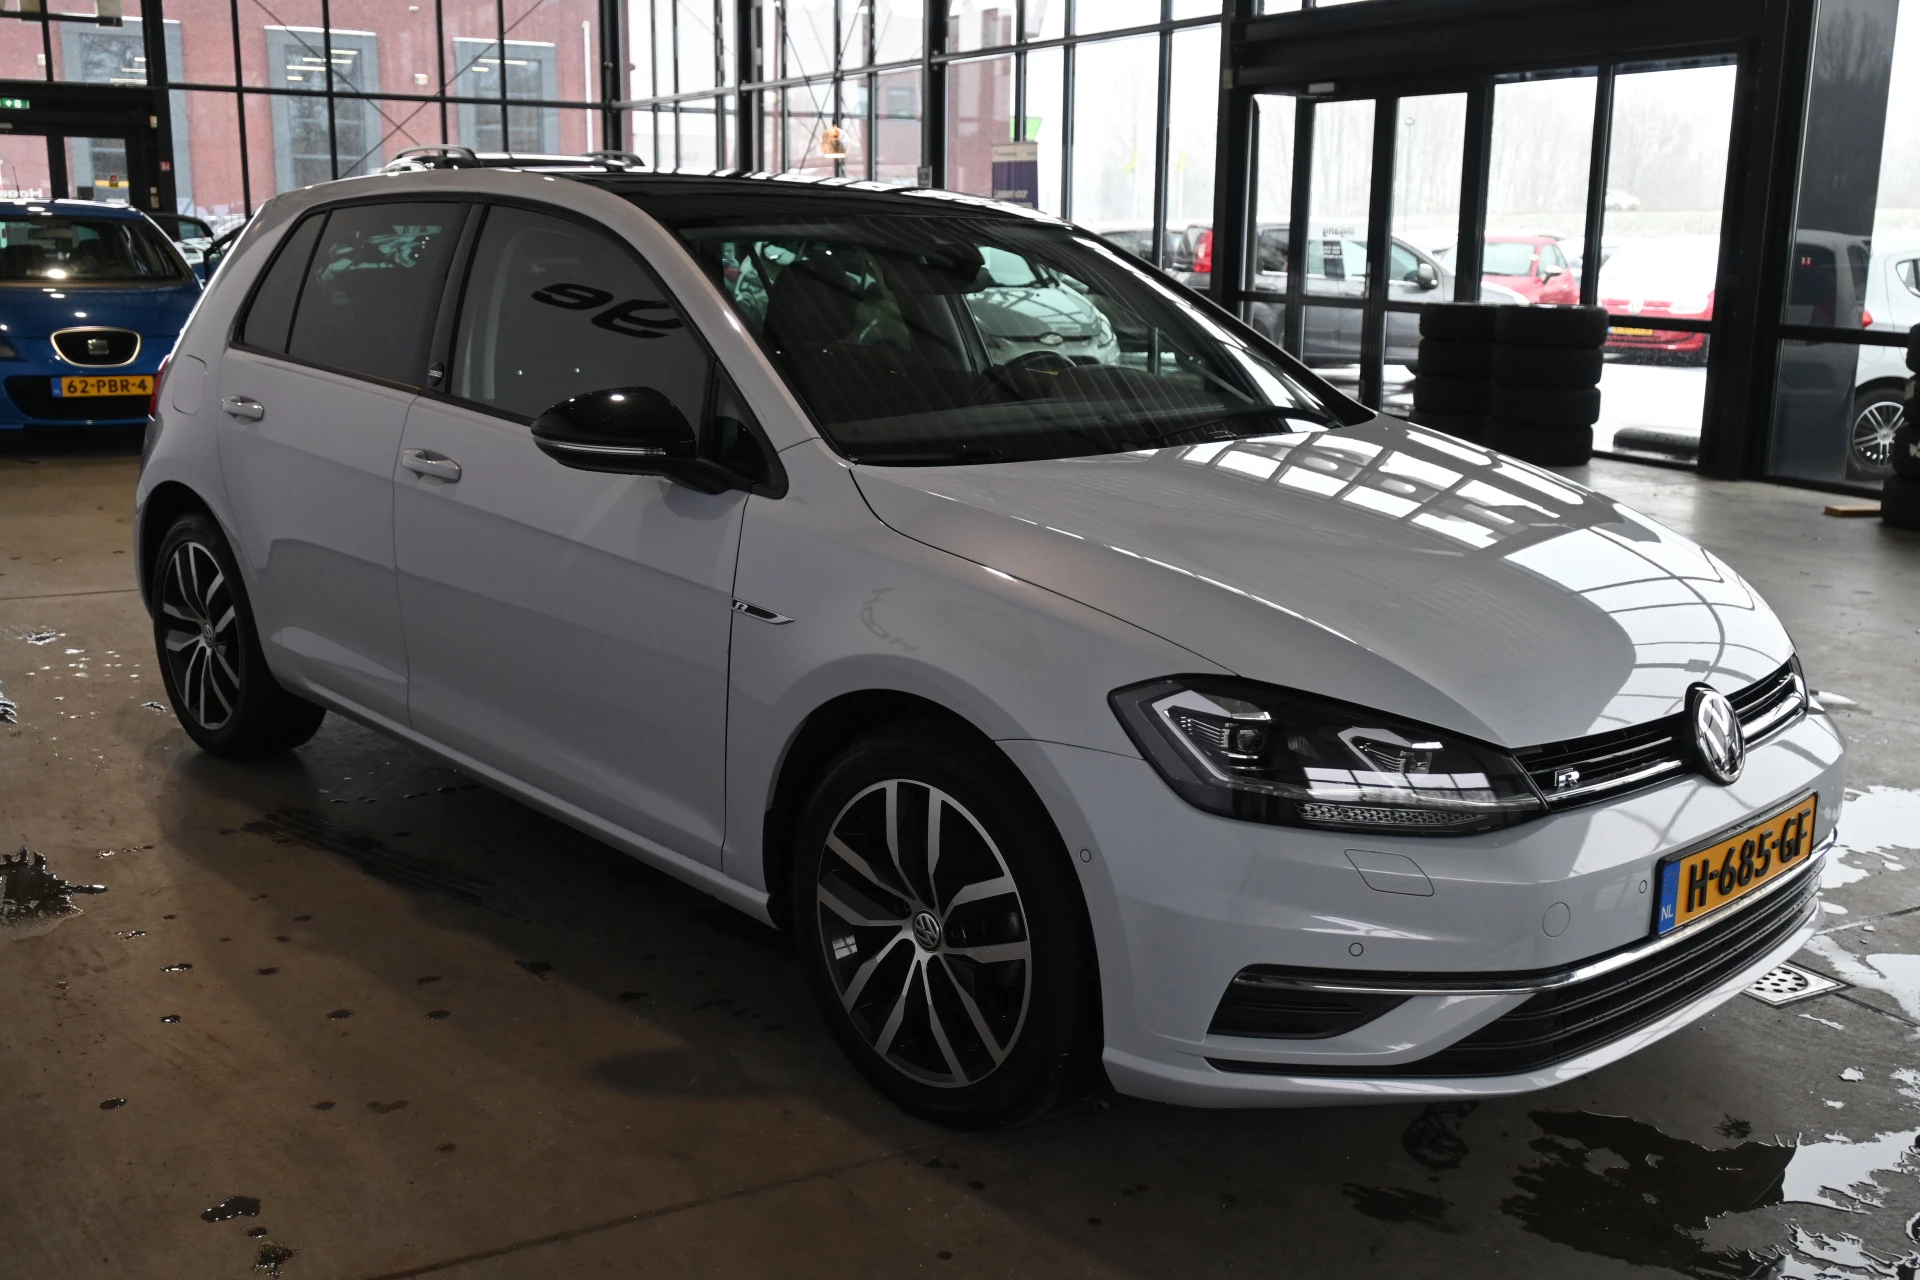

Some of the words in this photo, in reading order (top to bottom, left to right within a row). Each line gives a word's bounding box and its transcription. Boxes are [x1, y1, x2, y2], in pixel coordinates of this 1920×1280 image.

[67, 379, 148, 394] 62-PBR-4
[1660, 903, 1674, 921] NL
[1687, 808, 1811, 913] H-685-GF
